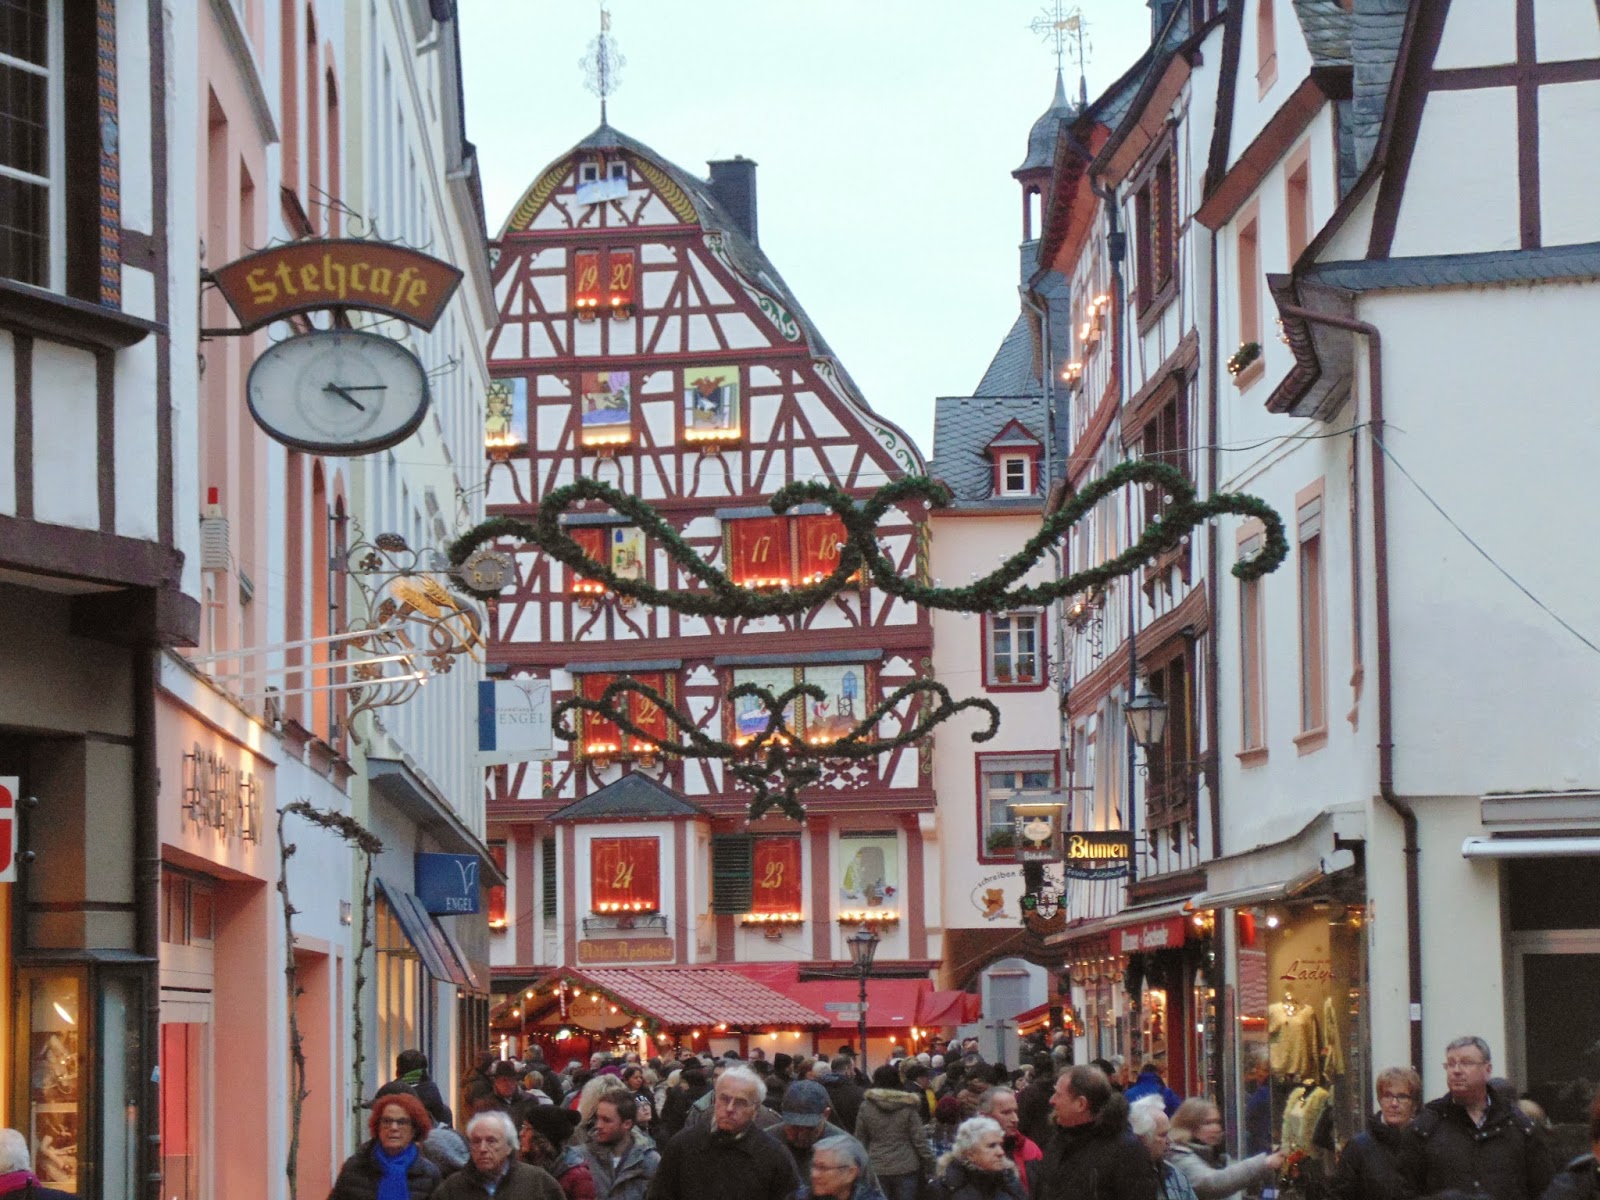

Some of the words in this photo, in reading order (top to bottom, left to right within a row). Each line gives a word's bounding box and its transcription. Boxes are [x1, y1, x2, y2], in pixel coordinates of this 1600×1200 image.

[245, 253, 428, 308] Stehcafe
[578, 265, 598, 292] 19
[609, 264, 633, 290] 20
[751, 536, 771, 563] 17
[818, 533, 838, 560] 18
[499, 712, 545, 725] ENGEL
[636, 697, 659, 725] 22
[1068, 835, 1130, 859] Blumen
[612, 862, 635, 888] 24
[762, 862, 784, 888] 23
[977, 871, 1016, 888] schreiben
[446, 897, 473, 911] ENGEL
